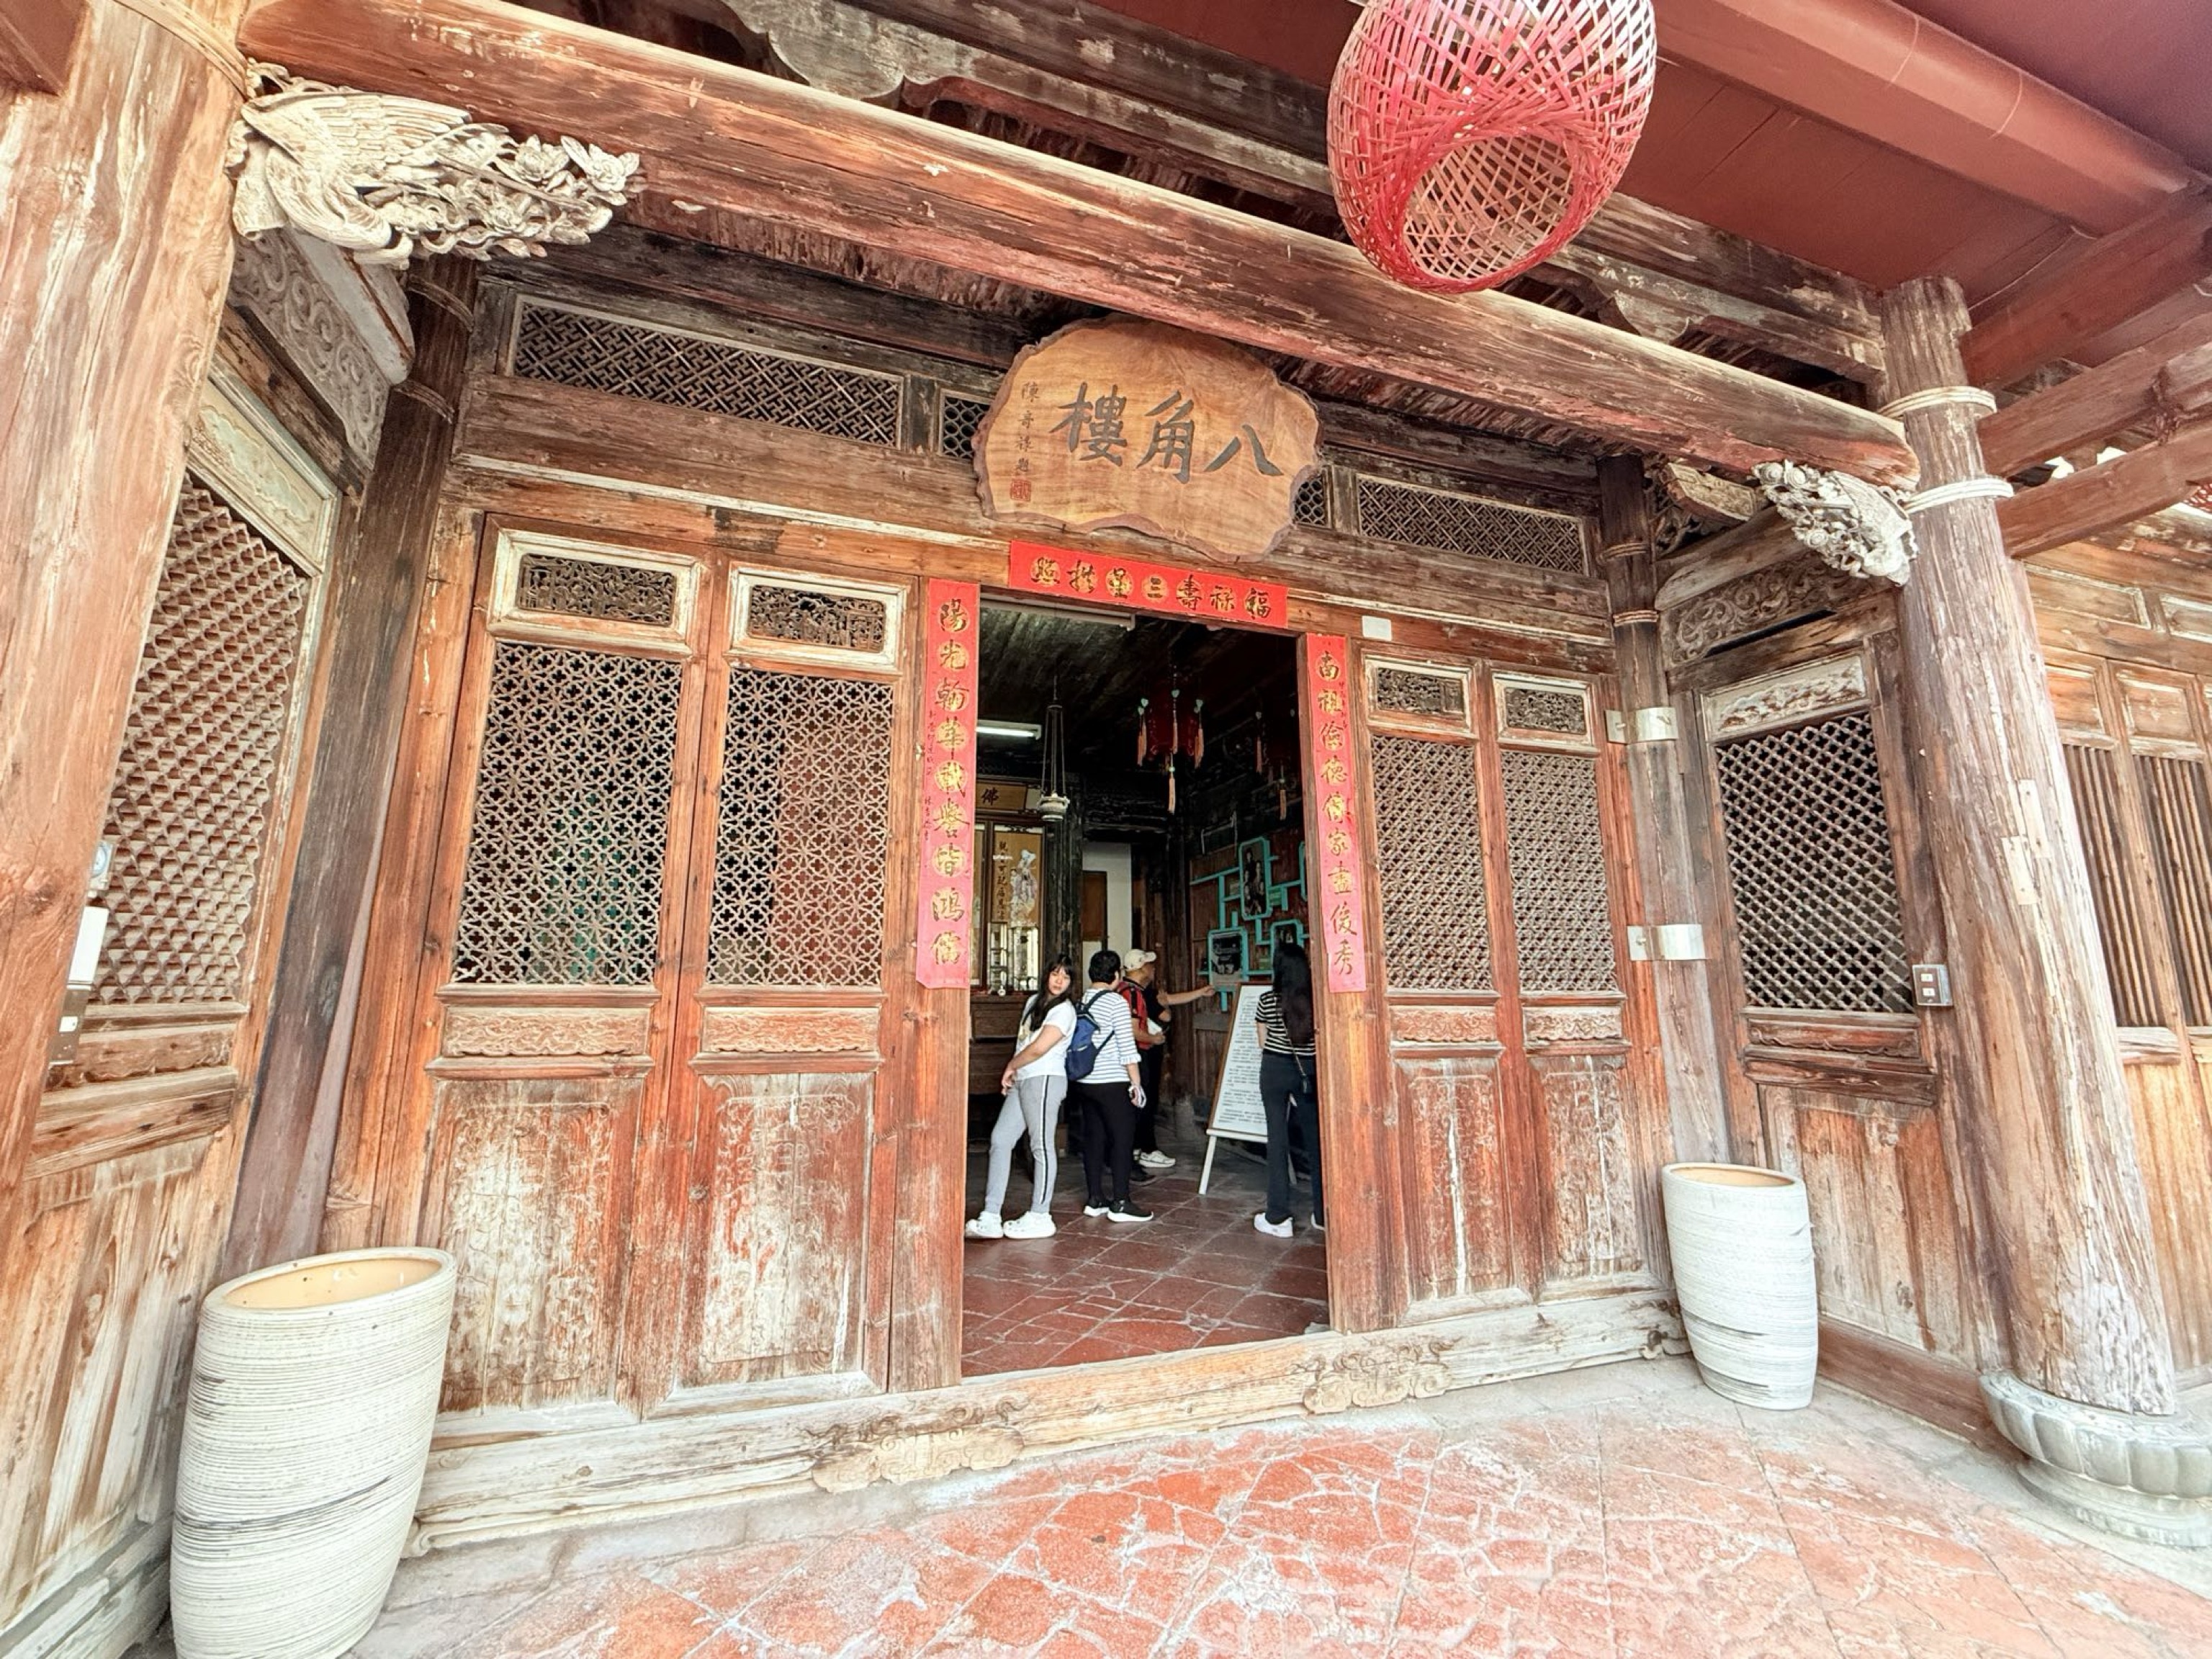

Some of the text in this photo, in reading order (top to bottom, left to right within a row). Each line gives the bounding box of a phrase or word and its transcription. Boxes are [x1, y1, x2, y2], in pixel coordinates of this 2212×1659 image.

[1048, 381, 1285, 485] 八角樓
[1030, 557, 1271, 620] 福祿壽三星拱照
